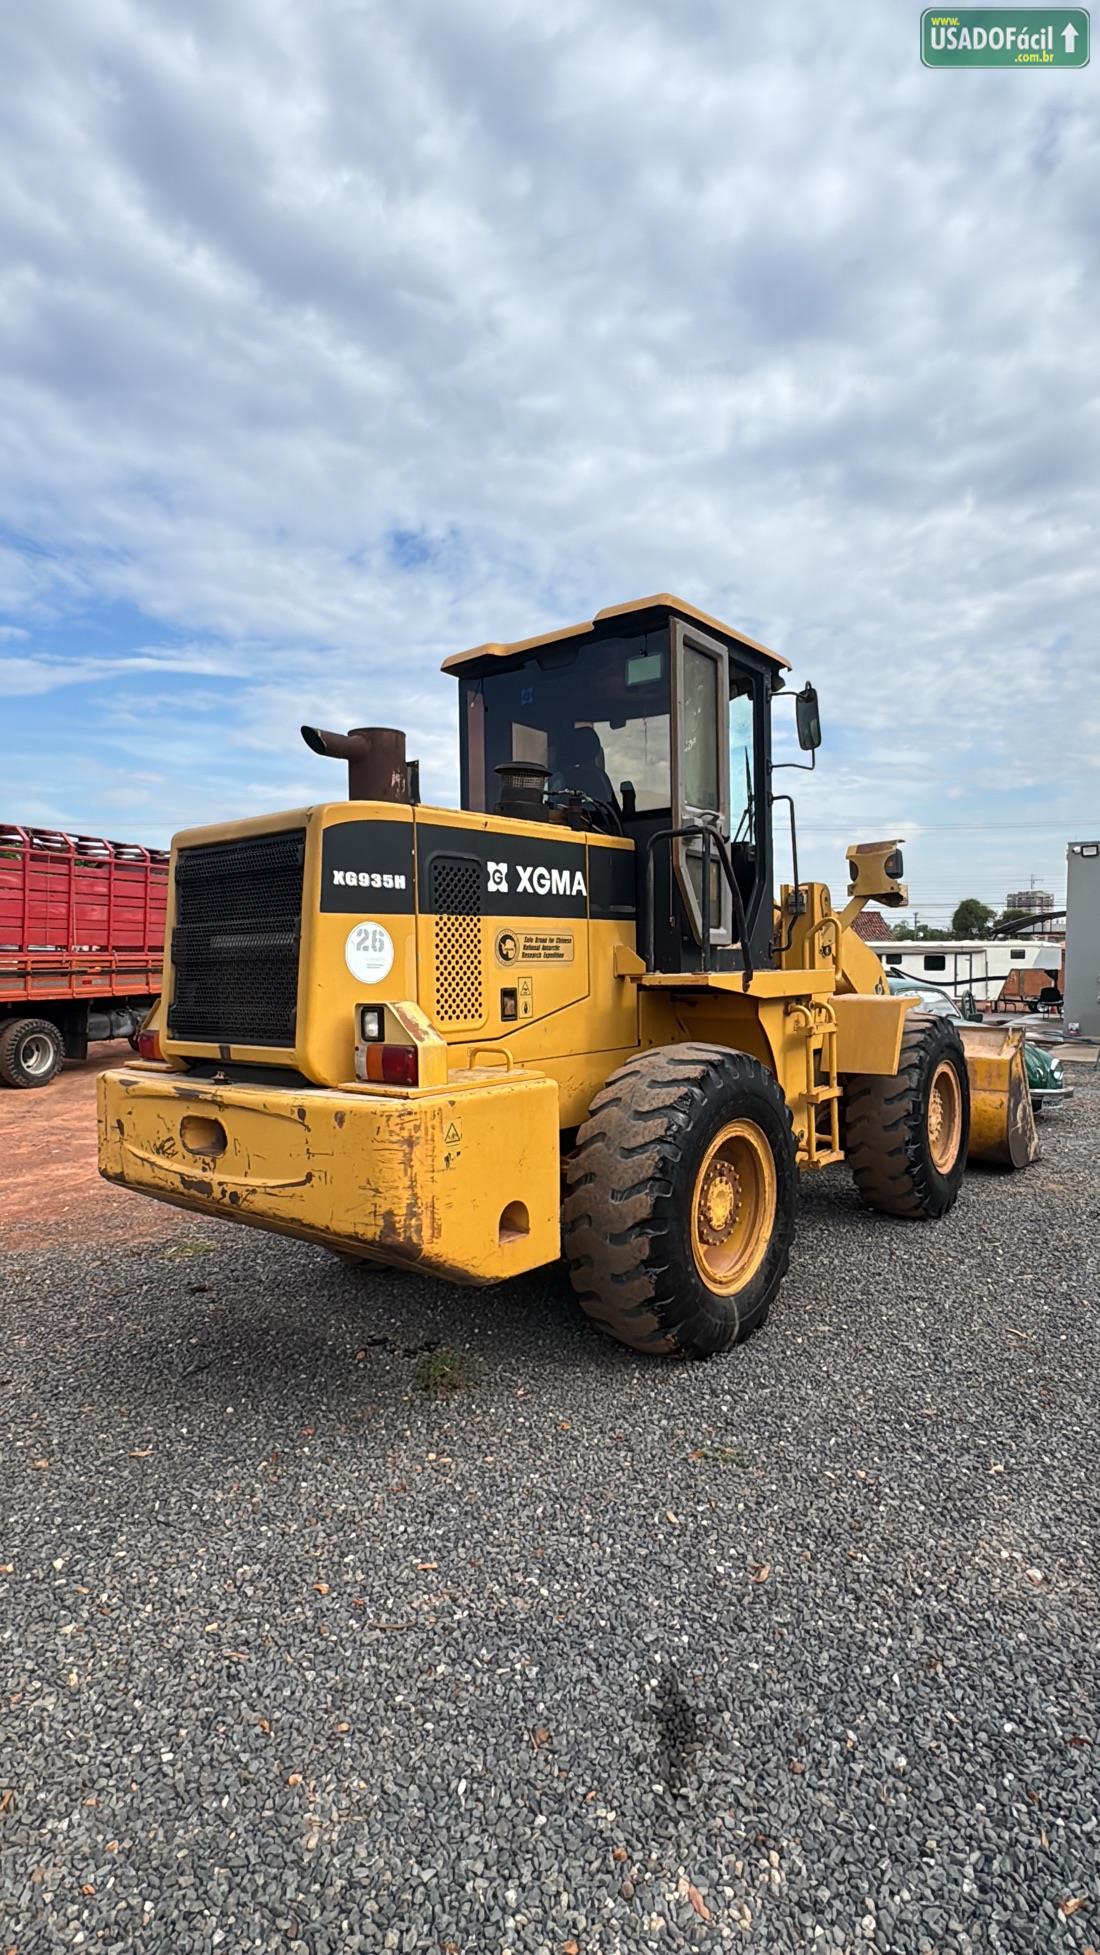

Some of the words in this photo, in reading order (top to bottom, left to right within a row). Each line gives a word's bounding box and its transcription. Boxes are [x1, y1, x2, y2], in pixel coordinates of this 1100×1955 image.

[332, 870, 406, 890] XG935H
[516, 865, 587, 896] XGMA
[356, 928, 385, 952] 26
